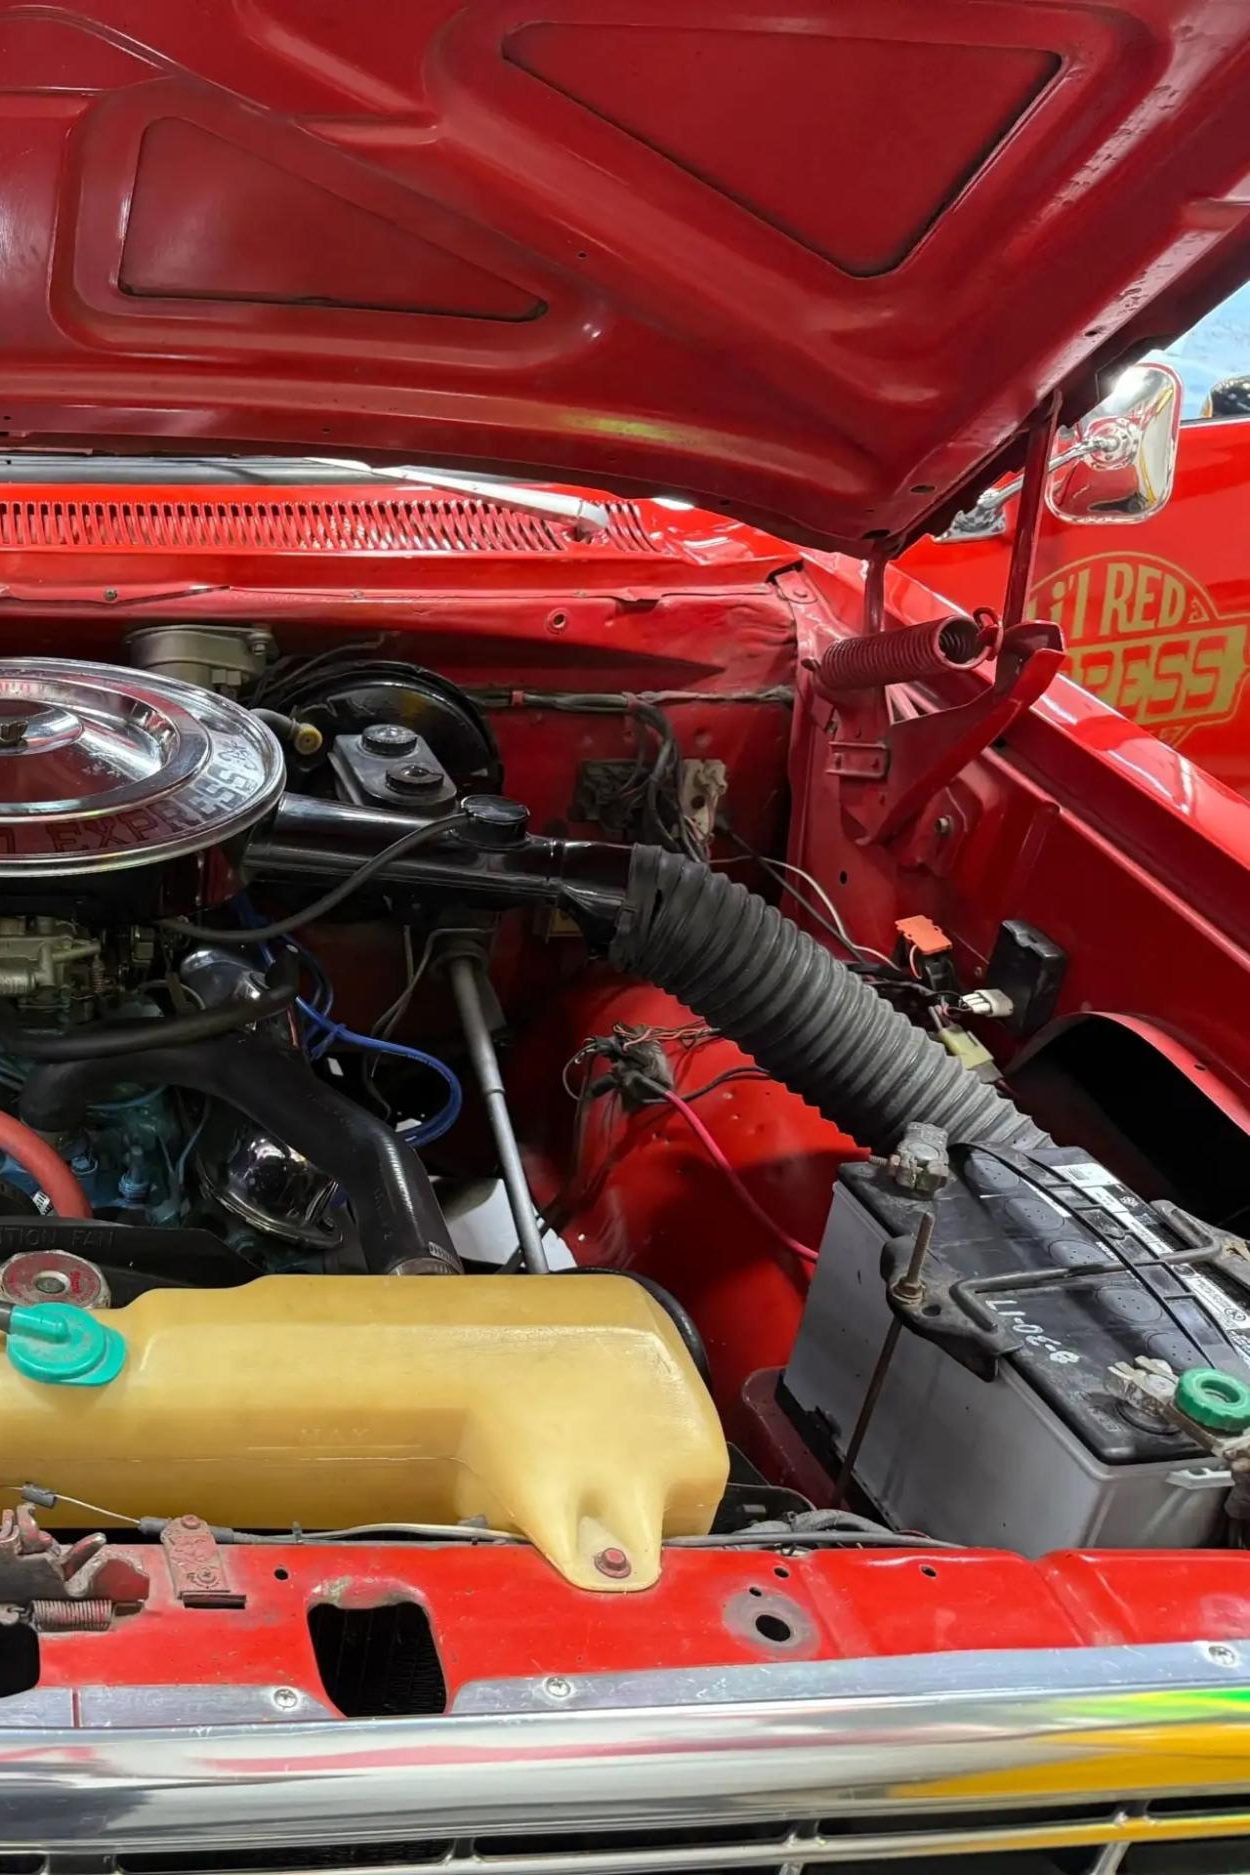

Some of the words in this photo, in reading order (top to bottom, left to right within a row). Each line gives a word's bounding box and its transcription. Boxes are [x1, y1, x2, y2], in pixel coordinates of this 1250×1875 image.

[1098, 562, 1187, 637] RED
[46, 768, 259, 853] EXPRESS
[71, 1229, 116, 1247] FAN
[985, 1300, 1081, 1364] 8-30-17
